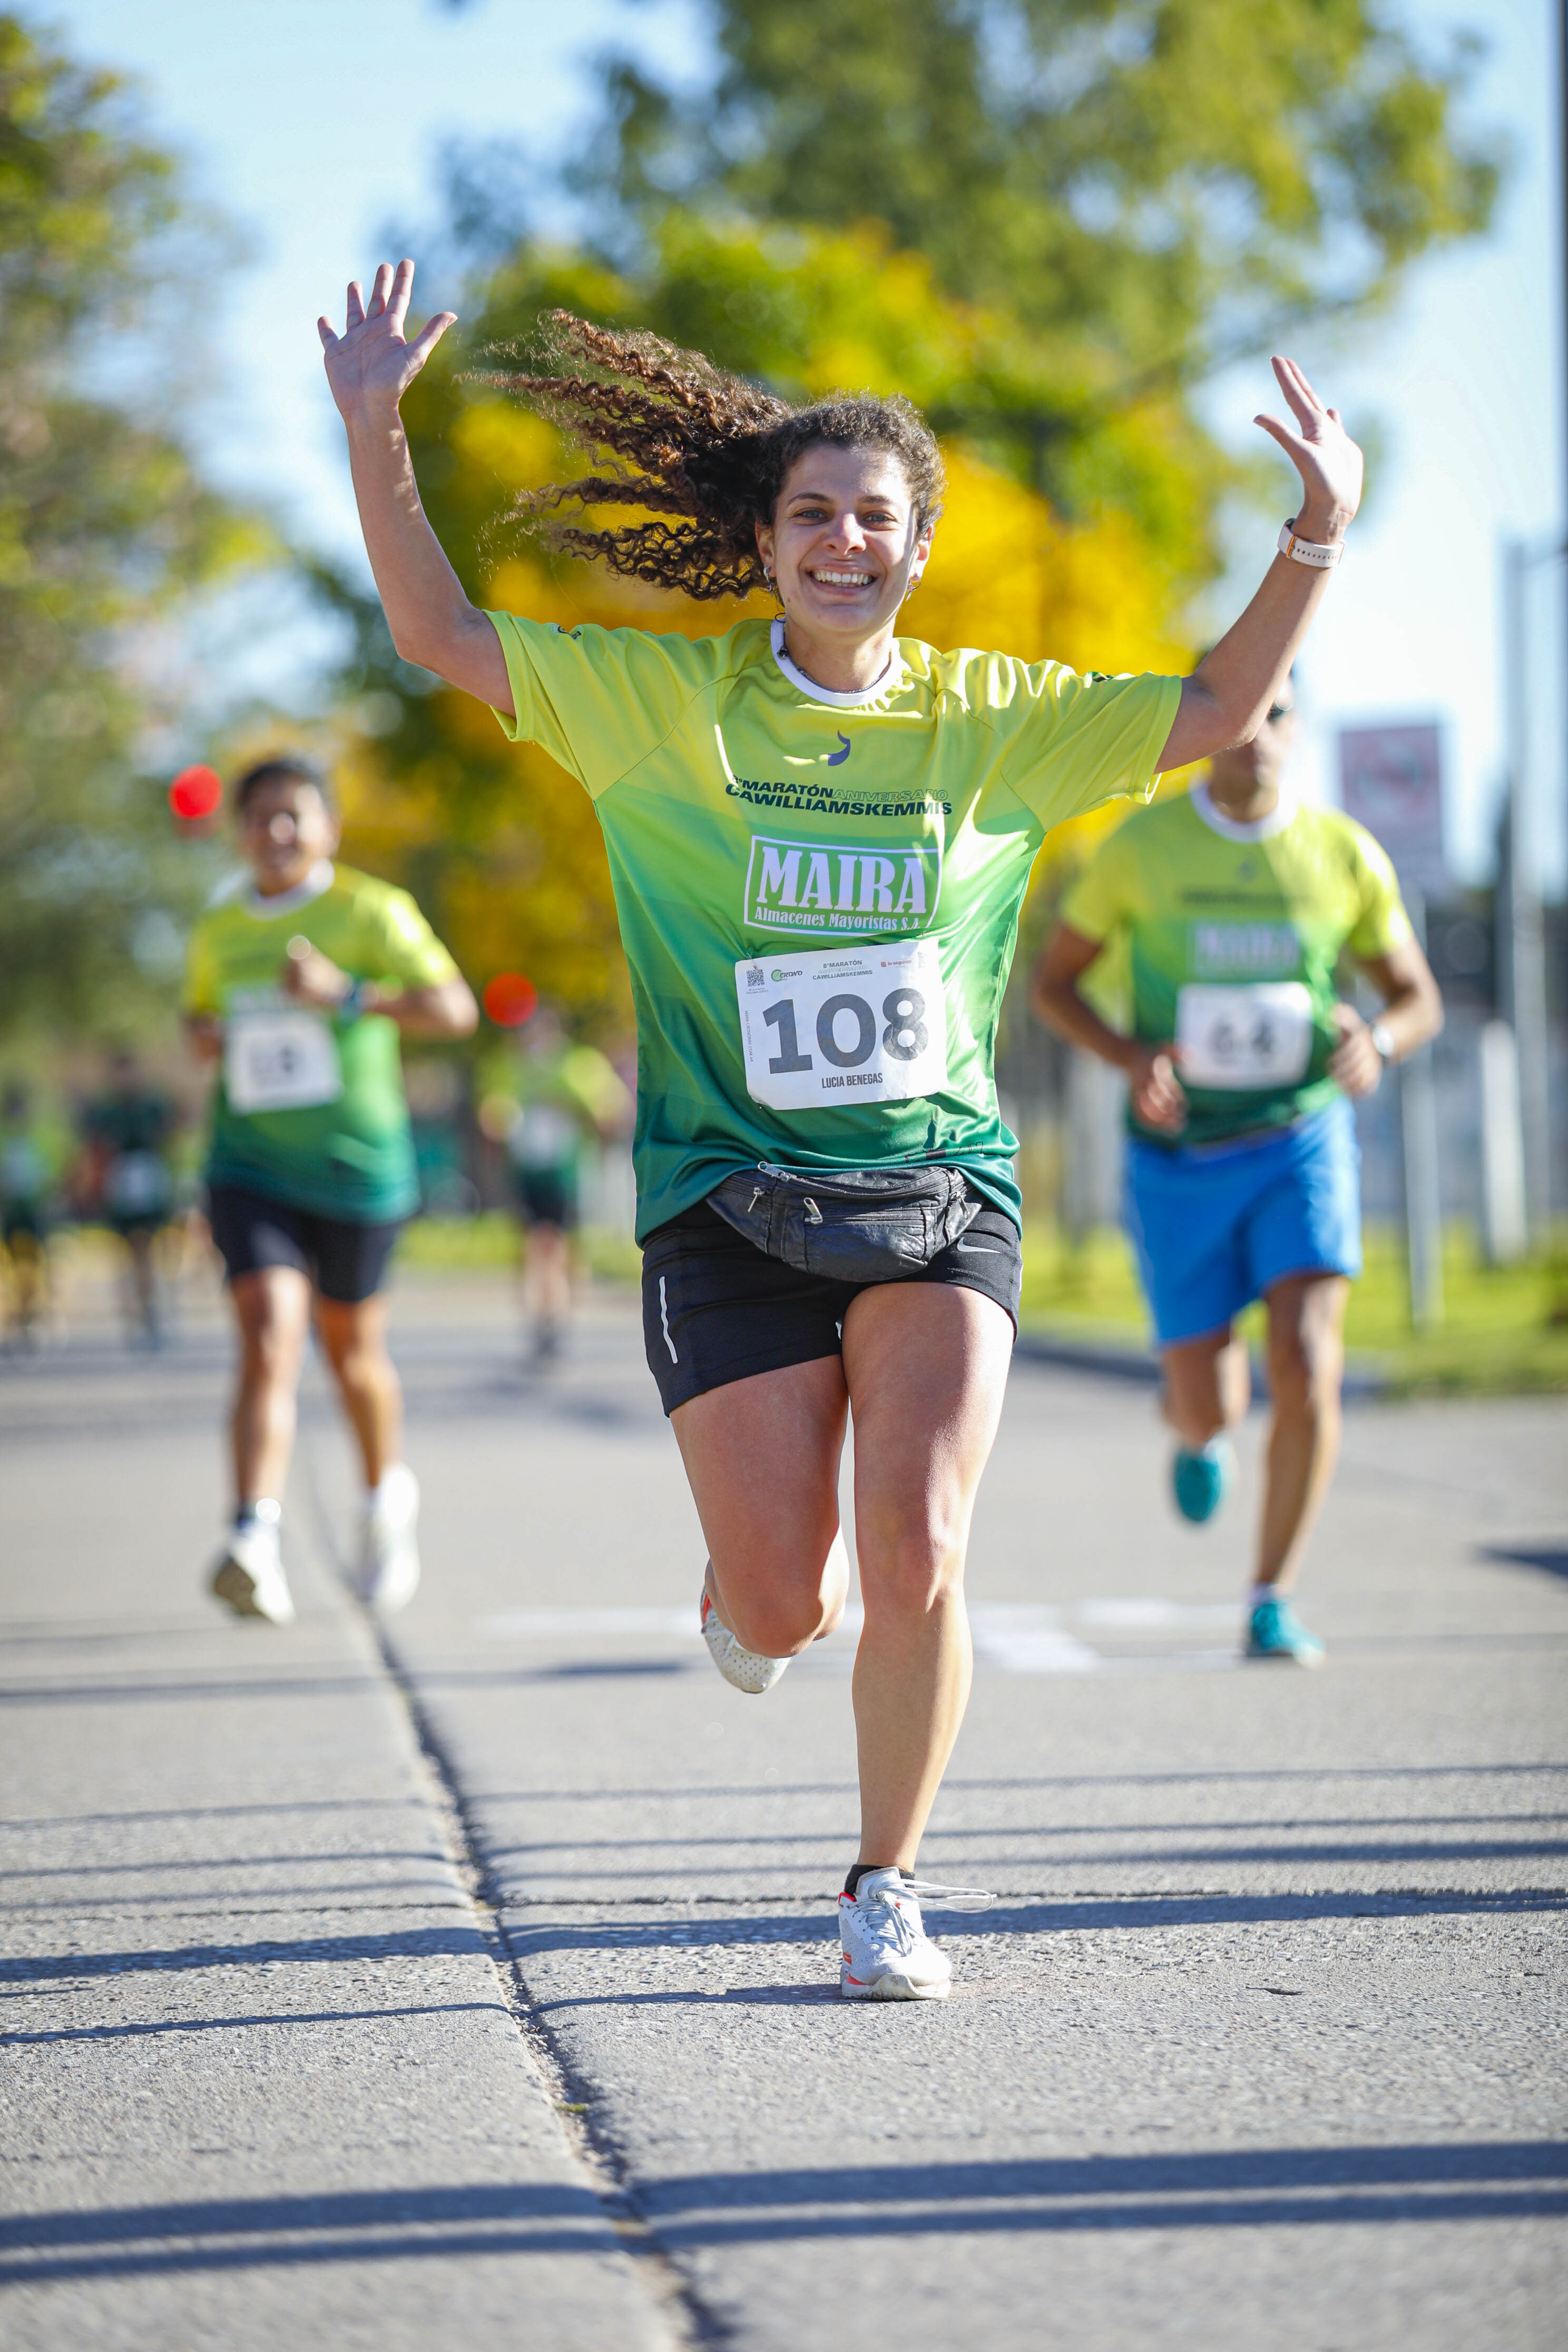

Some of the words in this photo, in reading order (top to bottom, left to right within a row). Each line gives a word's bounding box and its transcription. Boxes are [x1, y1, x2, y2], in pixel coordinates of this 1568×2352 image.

[726, 783, 952, 816] CAWILLIAMSKEMMIS
[756, 846, 926, 913] MAIRA
[754, 906, 825, 926] Almacenes
[829, 913, 897, 930] Mayoristas
[812, 970, 873, 979] CAWILLIAMSKEMMIS
[823, 959, 863, 968] 8°MARATÓN
[762, 988, 928, 1074] 108
[821, 1076, 845, 1089] LUCIA
[846, 1073, 883, 1086] BENEGAS
